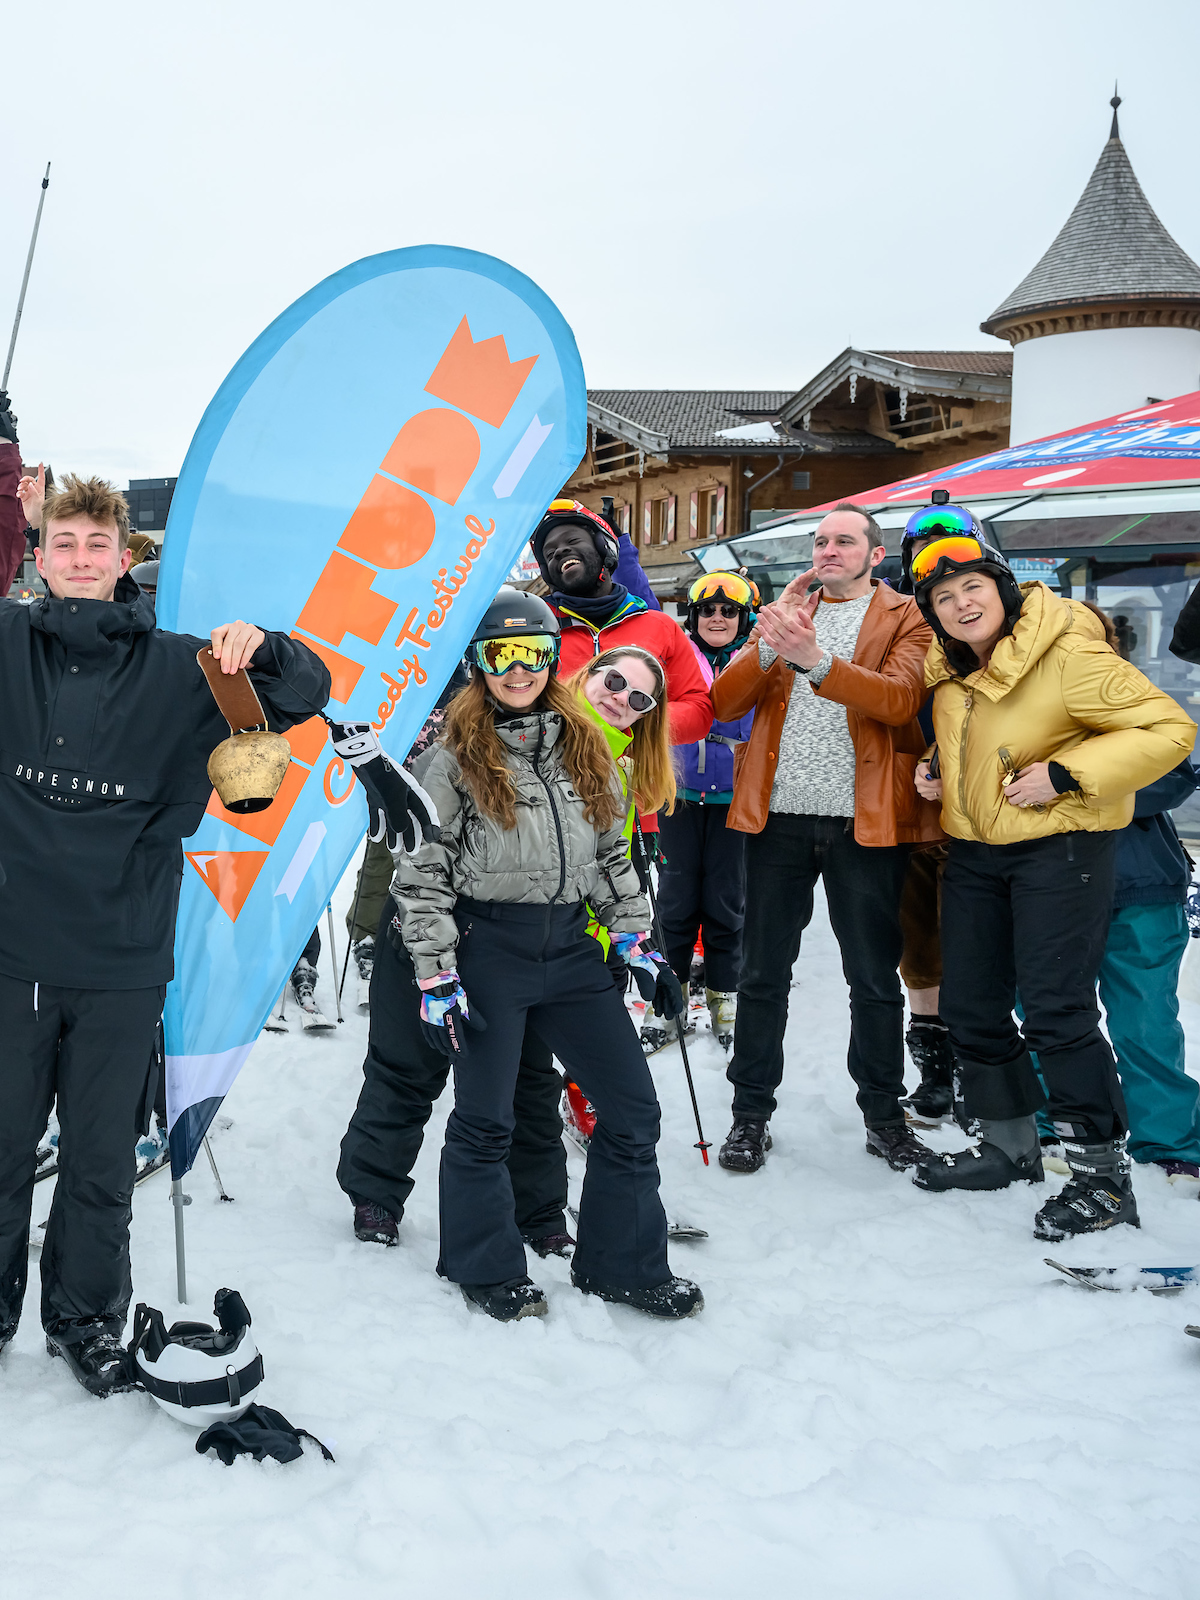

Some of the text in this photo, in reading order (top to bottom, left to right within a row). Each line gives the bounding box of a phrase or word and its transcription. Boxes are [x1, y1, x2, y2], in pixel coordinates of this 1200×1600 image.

[324, 516, 496, 806] Cedy Festival
[15, 764, 125, 796] DOPE SNOW
